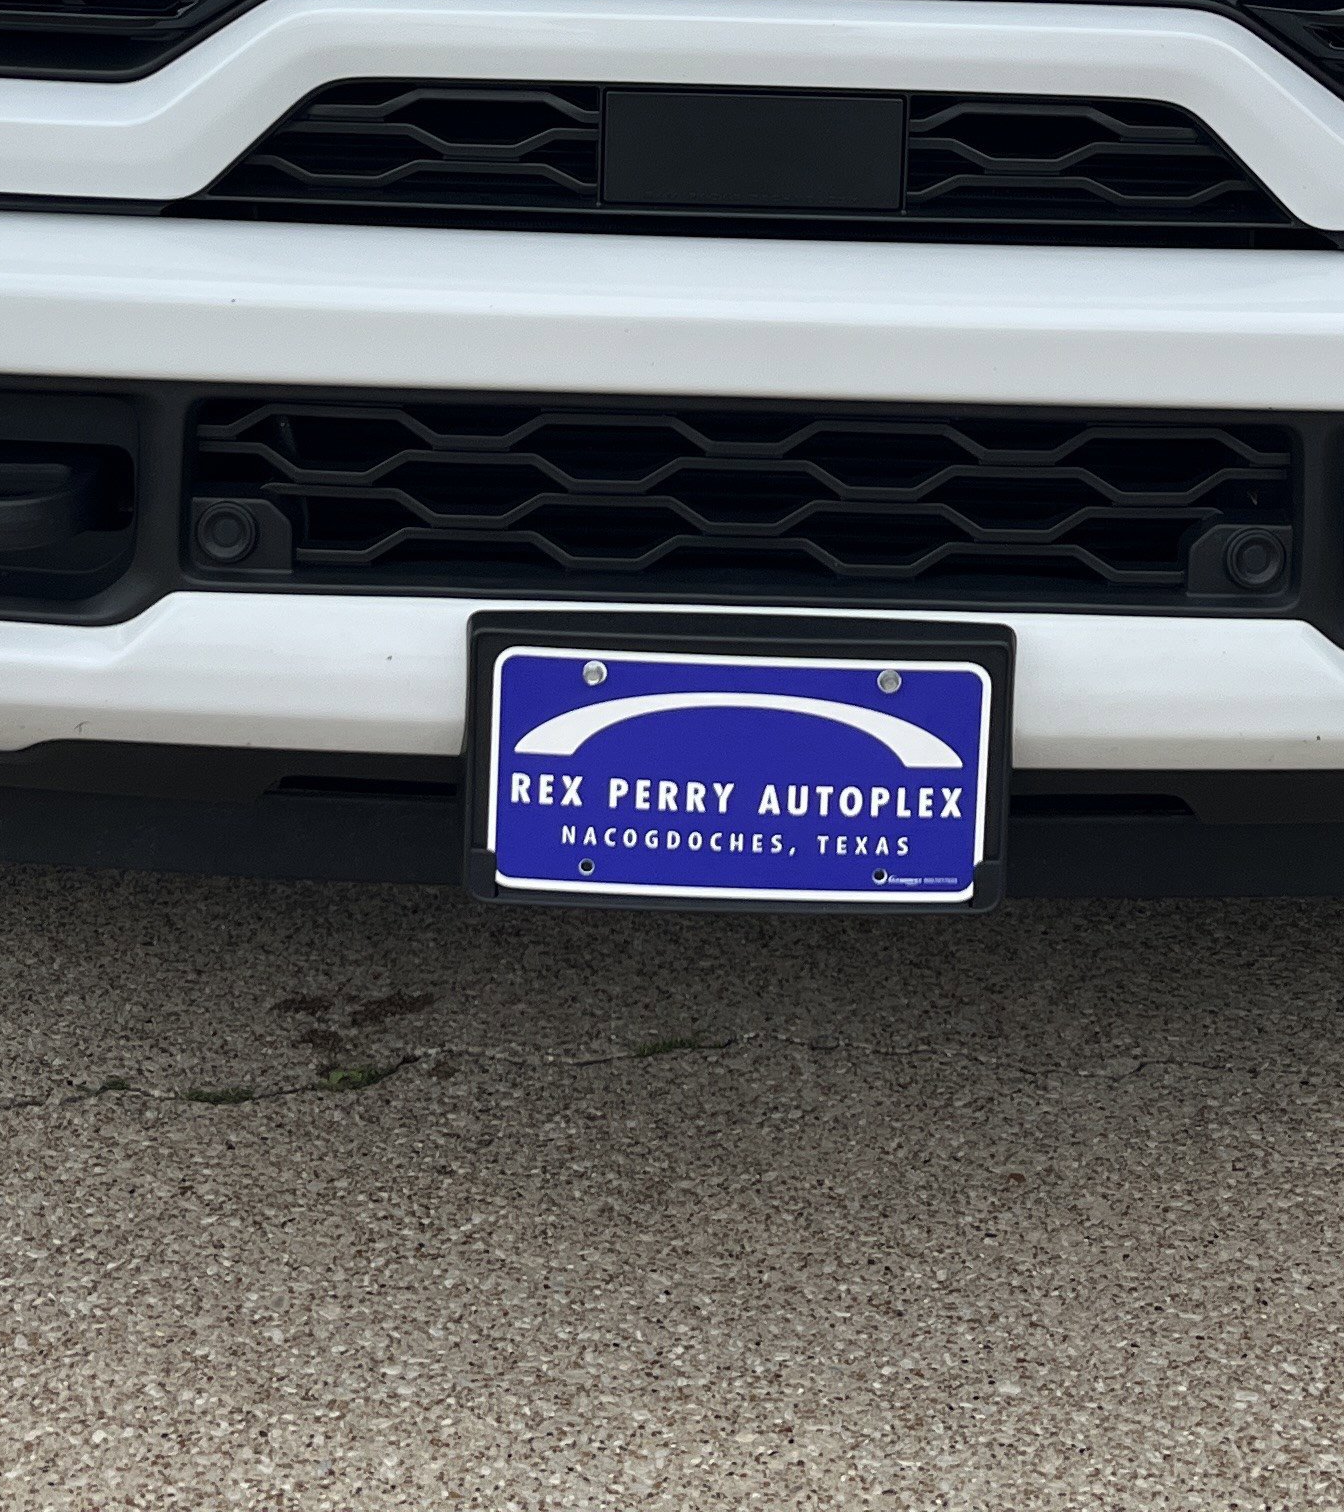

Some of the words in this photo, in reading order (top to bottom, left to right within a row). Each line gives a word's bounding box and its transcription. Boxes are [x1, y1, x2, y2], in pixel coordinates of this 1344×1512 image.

[511, 772, 584, 807] REX
[608, 777, 735, 814] PERRY
[758, 784, 963, 819] AUTOPLEX
[561, 824, 796, 856] NACOGDOCHES,
[817, 835, 909, 856] TEXAS
